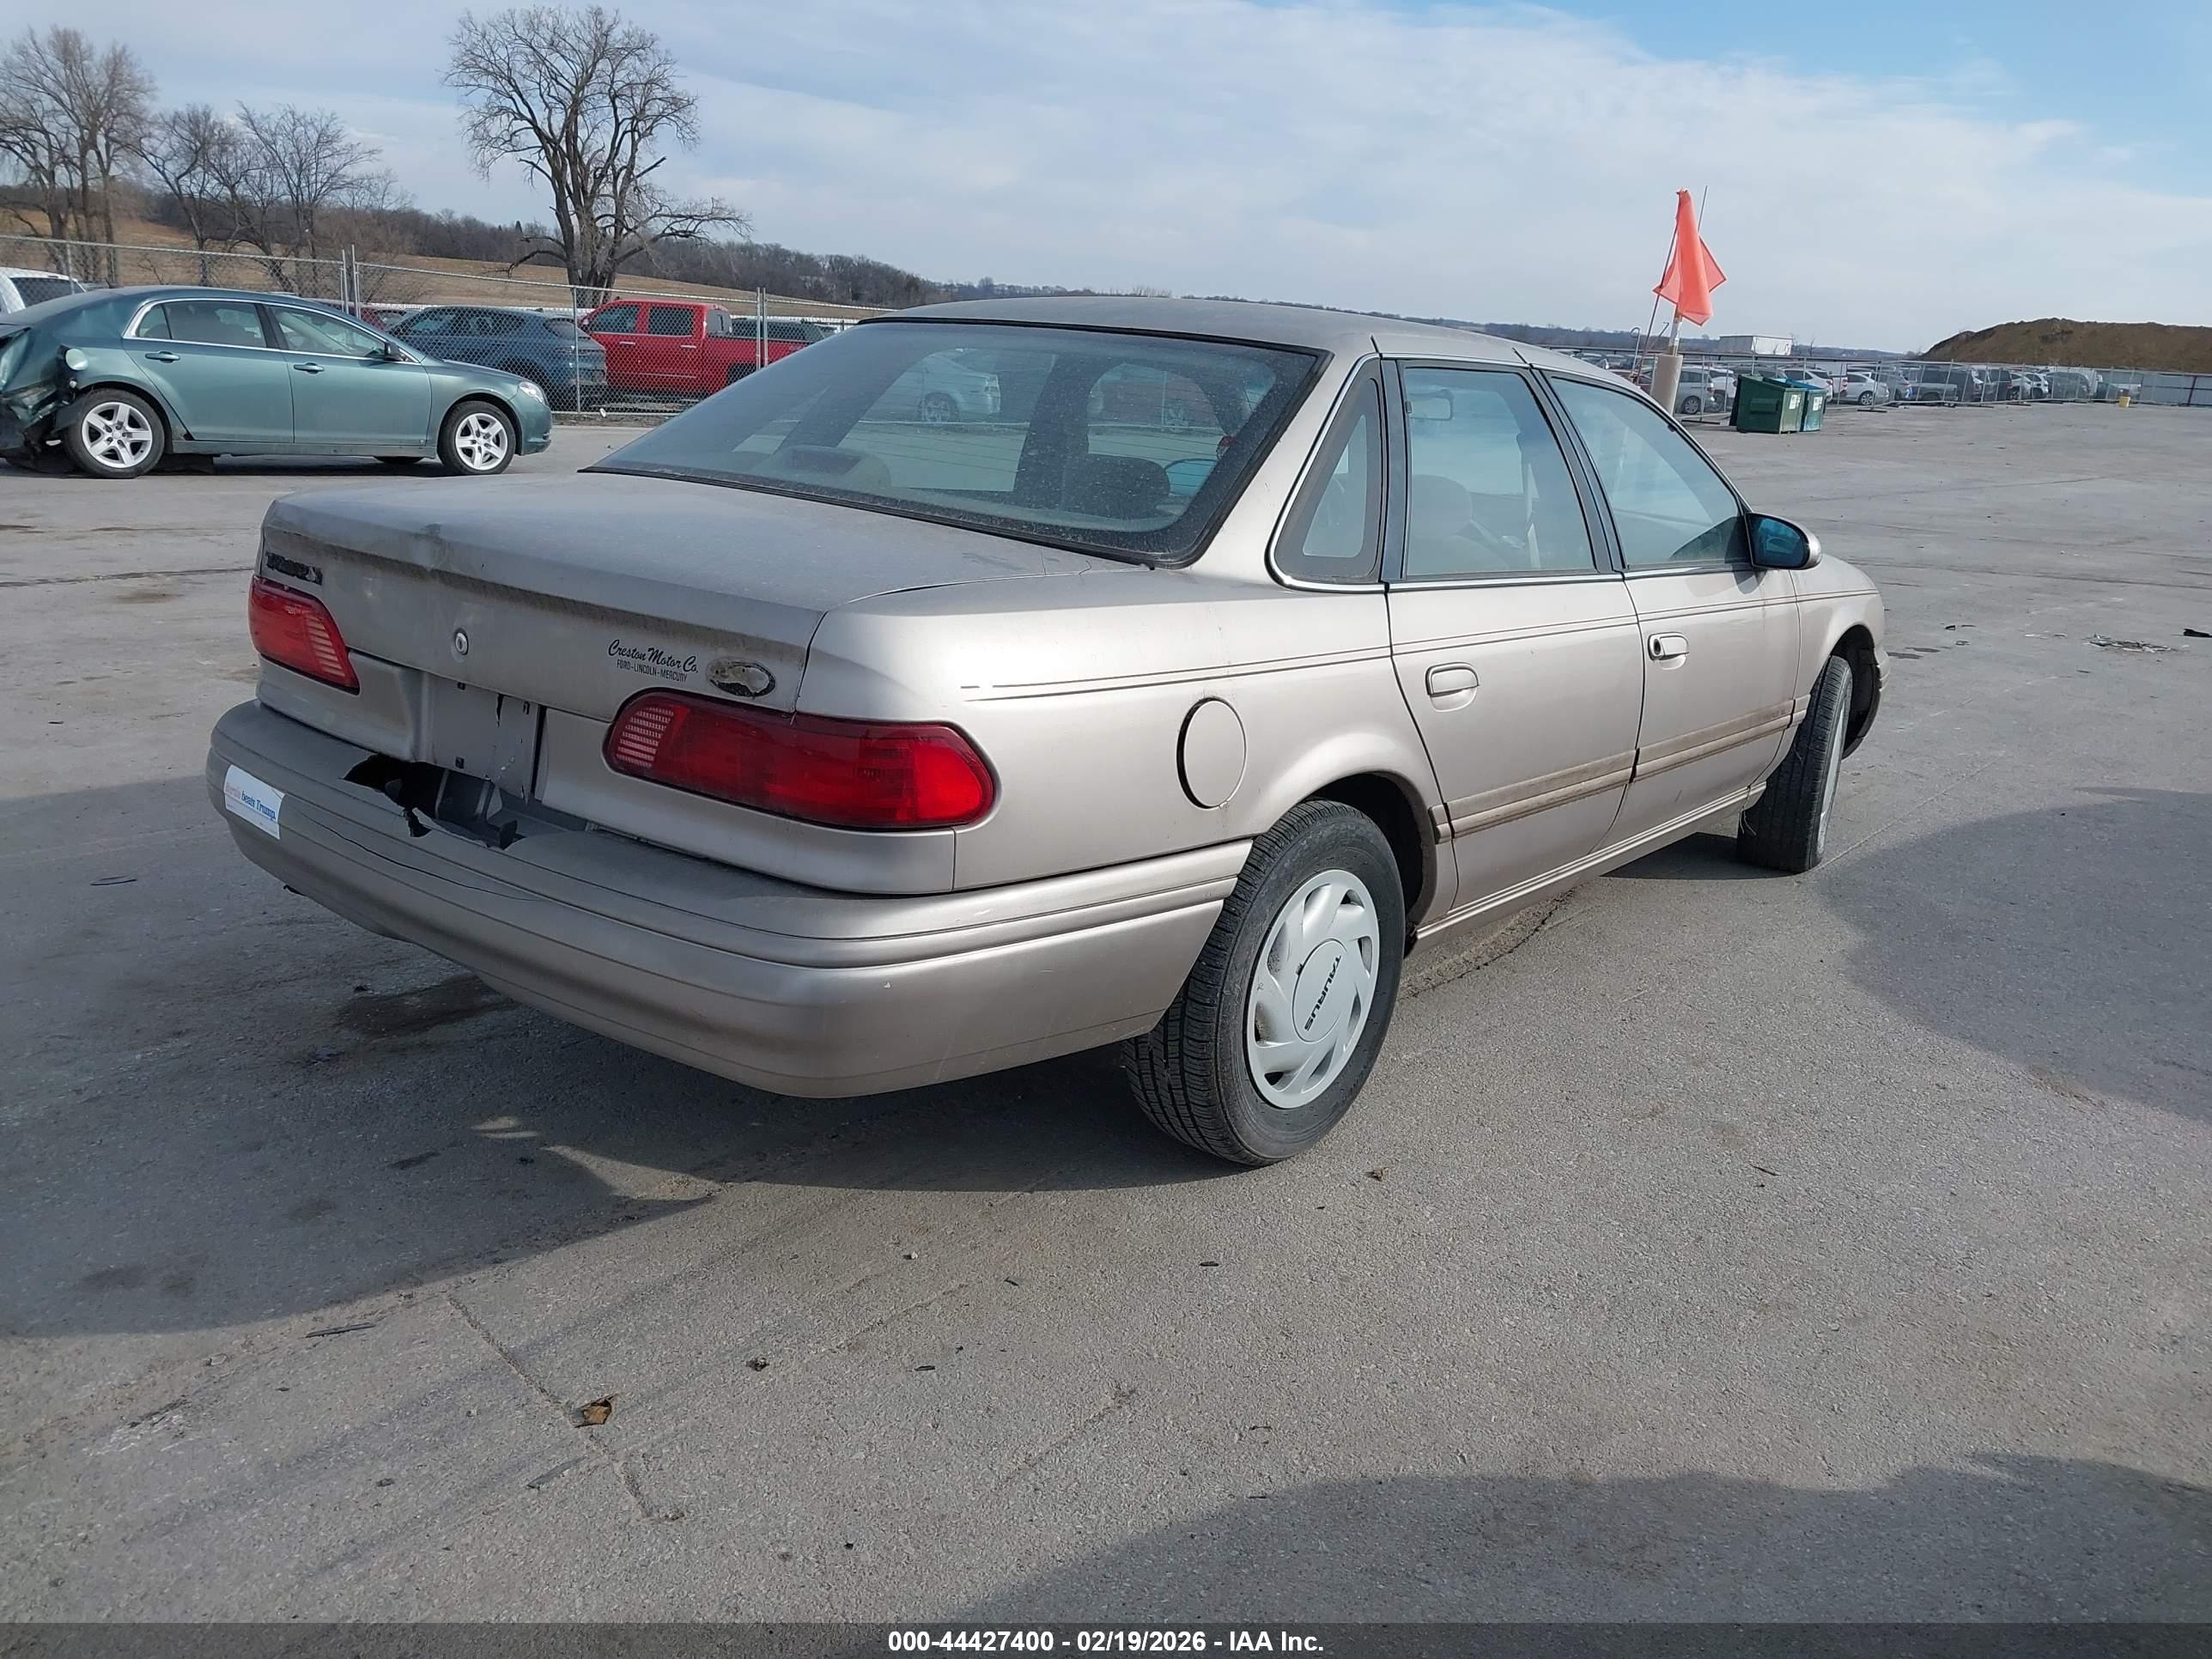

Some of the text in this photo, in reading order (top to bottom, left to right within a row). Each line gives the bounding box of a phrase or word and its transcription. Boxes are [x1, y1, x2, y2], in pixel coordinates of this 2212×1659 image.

[608, 640, 646, 660] Creston
[647, 647, 681, 668] Motor
[1304, 954, 1342, 1031] TAURUS
